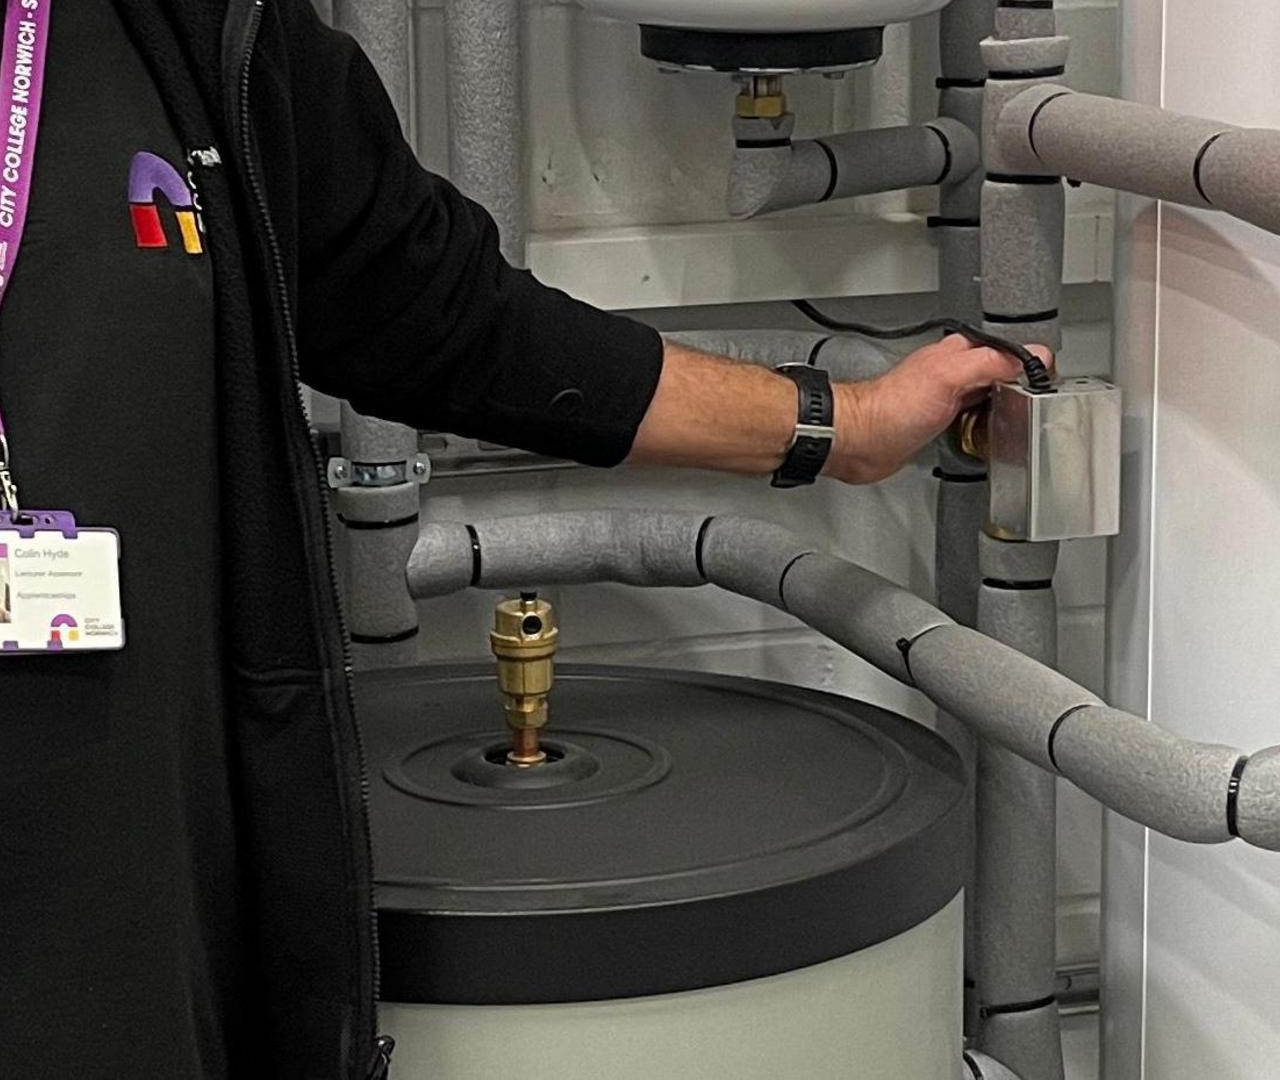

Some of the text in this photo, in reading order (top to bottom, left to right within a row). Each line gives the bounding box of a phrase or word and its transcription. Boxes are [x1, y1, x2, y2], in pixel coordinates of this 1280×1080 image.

[12, 20, 37, 104] NORWICH
[3, 105, 28, 183] COLLEGE
[14, 548, 70, 561] Colin Hyde
